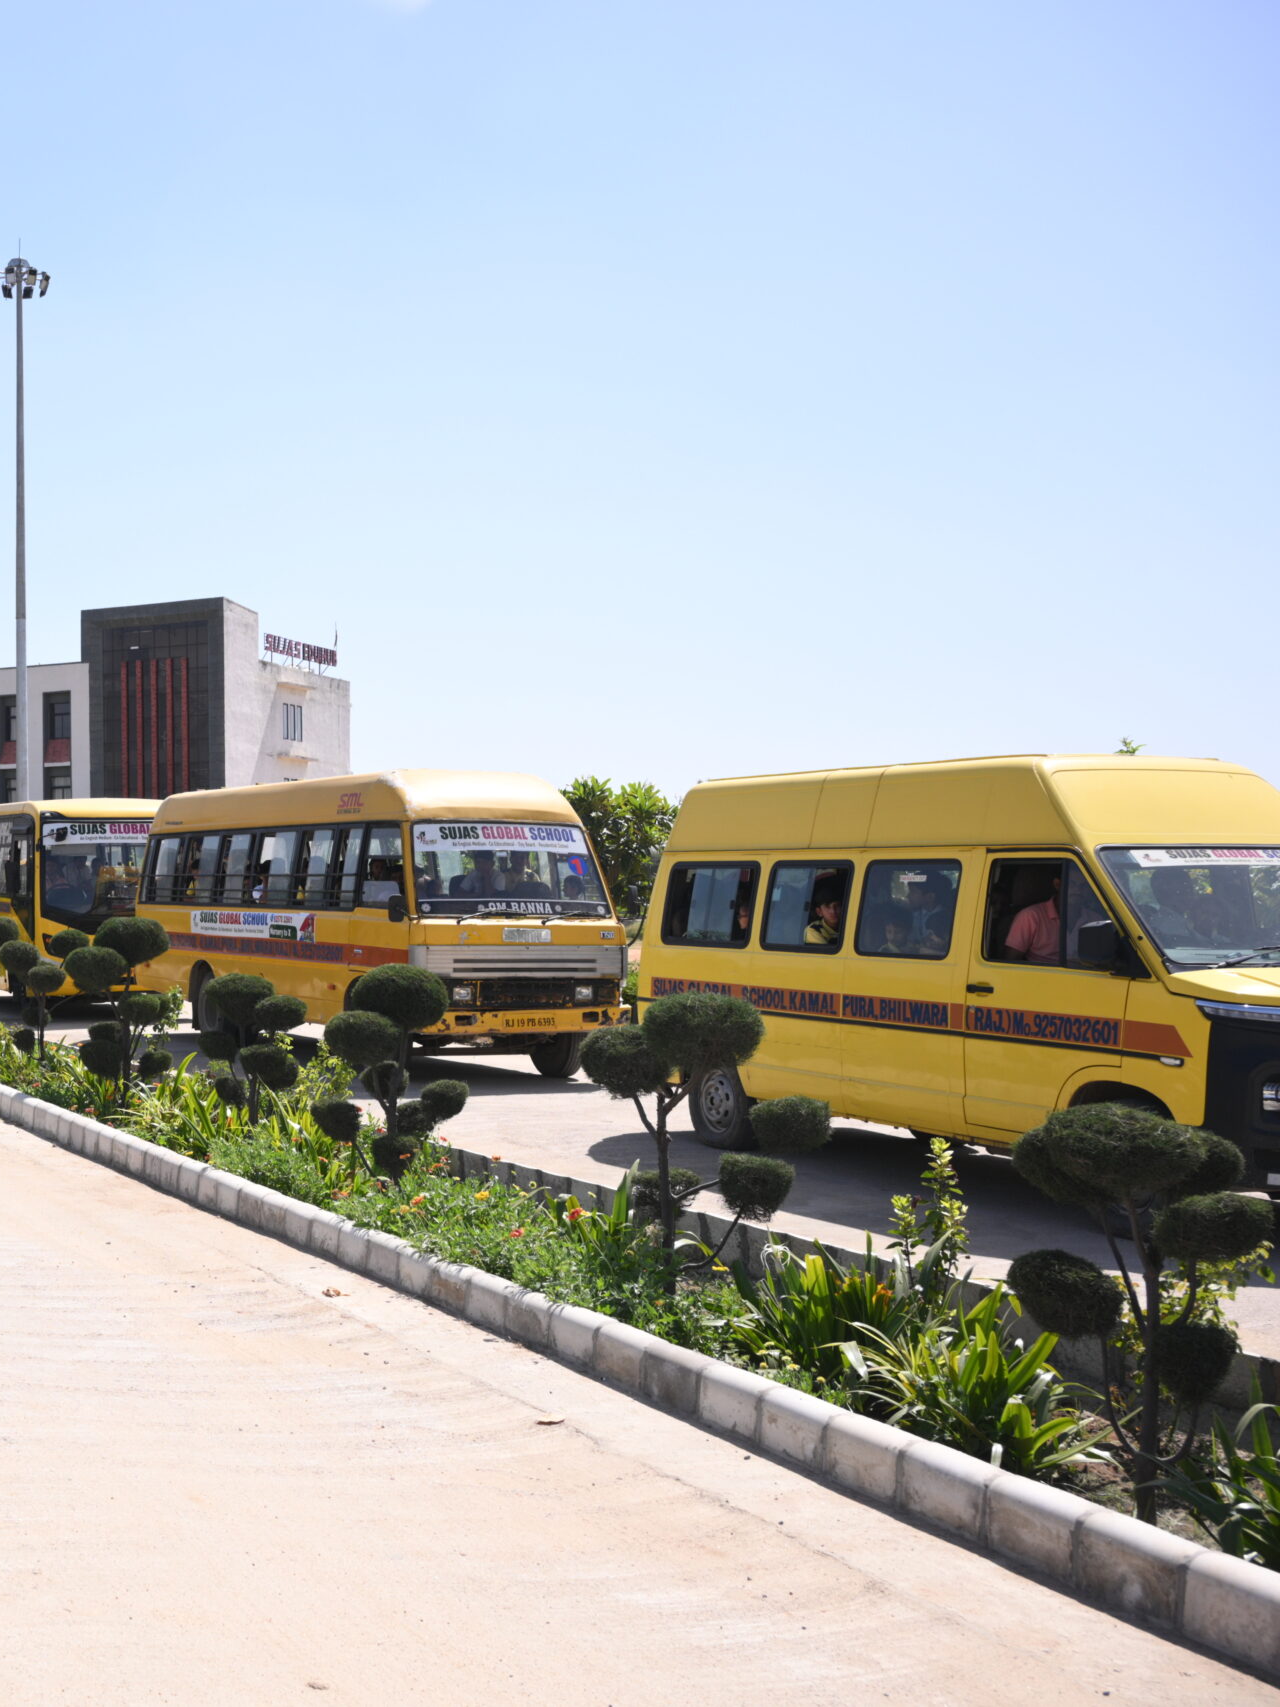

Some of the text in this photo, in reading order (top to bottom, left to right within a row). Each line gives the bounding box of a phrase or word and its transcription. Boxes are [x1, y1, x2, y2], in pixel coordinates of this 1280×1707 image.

[264, 633, 301, 659] SUJAS
[337, 792, 365, 808] SML
[70, 823, 107, 835] SUJAS
[439, 826, 576, 842] SUJAS GLOBAL SCHOOL
[1165, 849, 1211, 859] SUJAS
[1211, 849, 1265, 858] GLOBAL
[571, 858, 584, 875] 1
[510, 902, 553, 914] BANNA
[199, 911, 269, 926] SUJAS GLOBAL SCHOOL
[653, 978, 684, 996] SUJAS
[742, 985, 787, 1009] SCHOOL
[789, 991, 837, 1015] KAMAL
